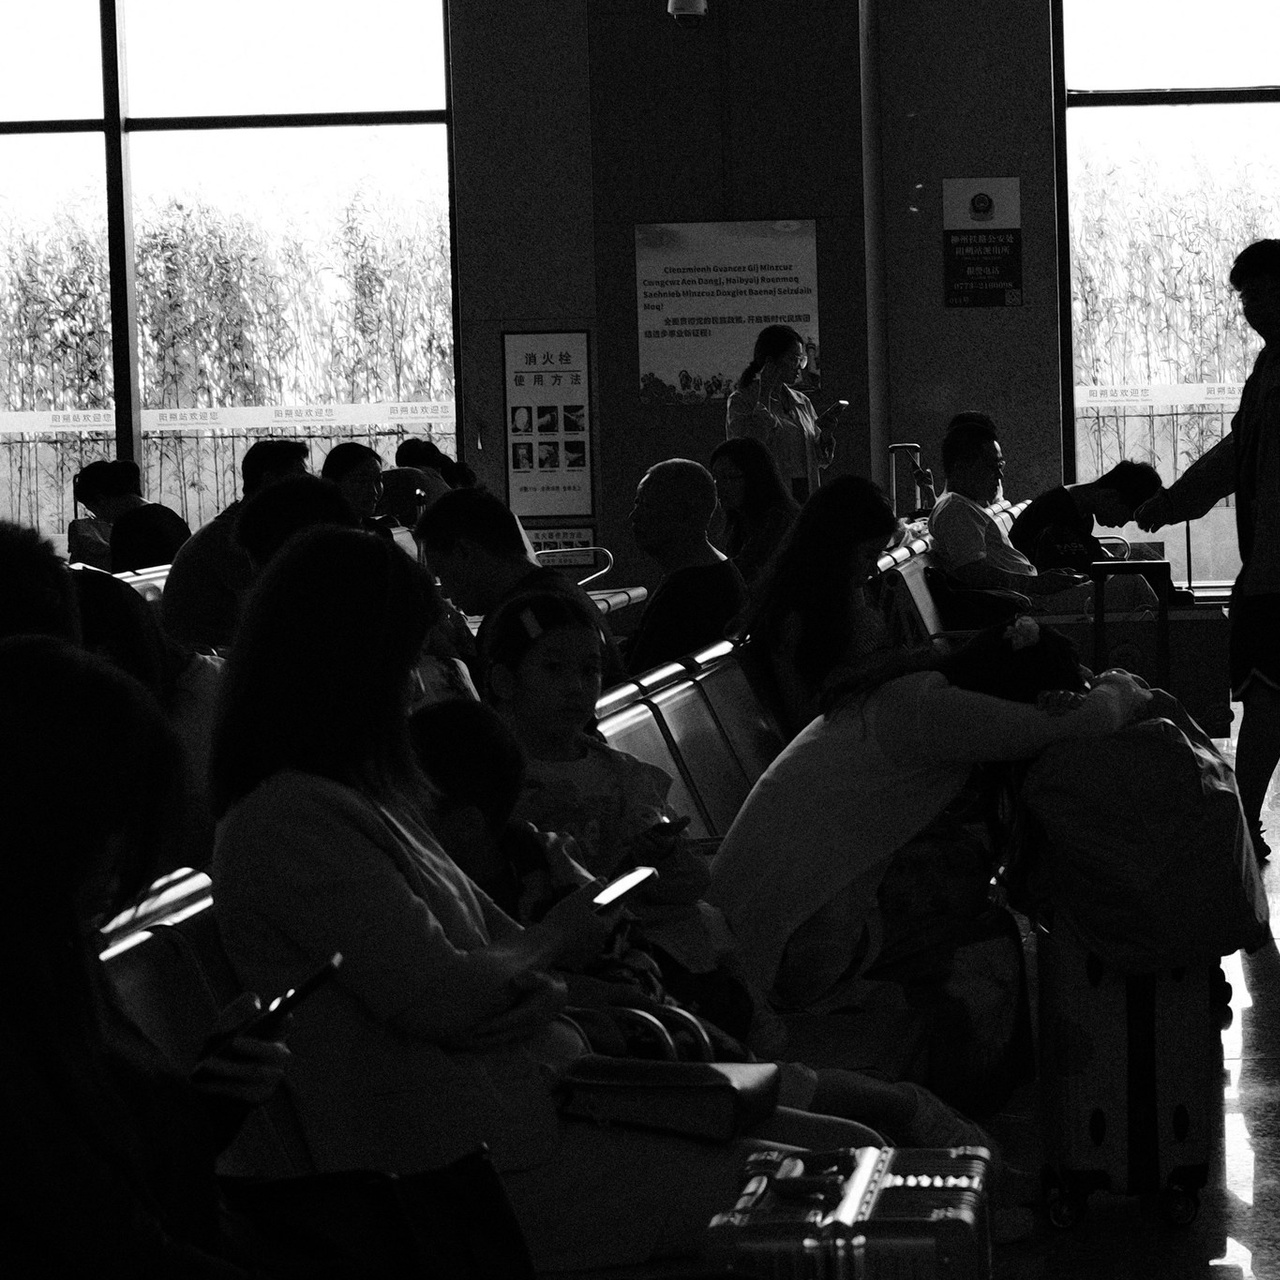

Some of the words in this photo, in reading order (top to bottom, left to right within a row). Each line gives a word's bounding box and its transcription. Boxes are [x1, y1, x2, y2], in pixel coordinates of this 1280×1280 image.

[713, 265, 746, 273] Gvancez
[748, 264, 759, 273] Gij
[681, 278, 697, 286] Aen
[525, 351, 572, 366] 消火栓
[513, 374, 582, 386] 使用方法
[1089, 388, 1150, 398] 阳朔站欢迎您
[274, 408, 334, 418] 阳朔站欢迎您
[389, 405, 450, 415] 阳朔站欢迎您
